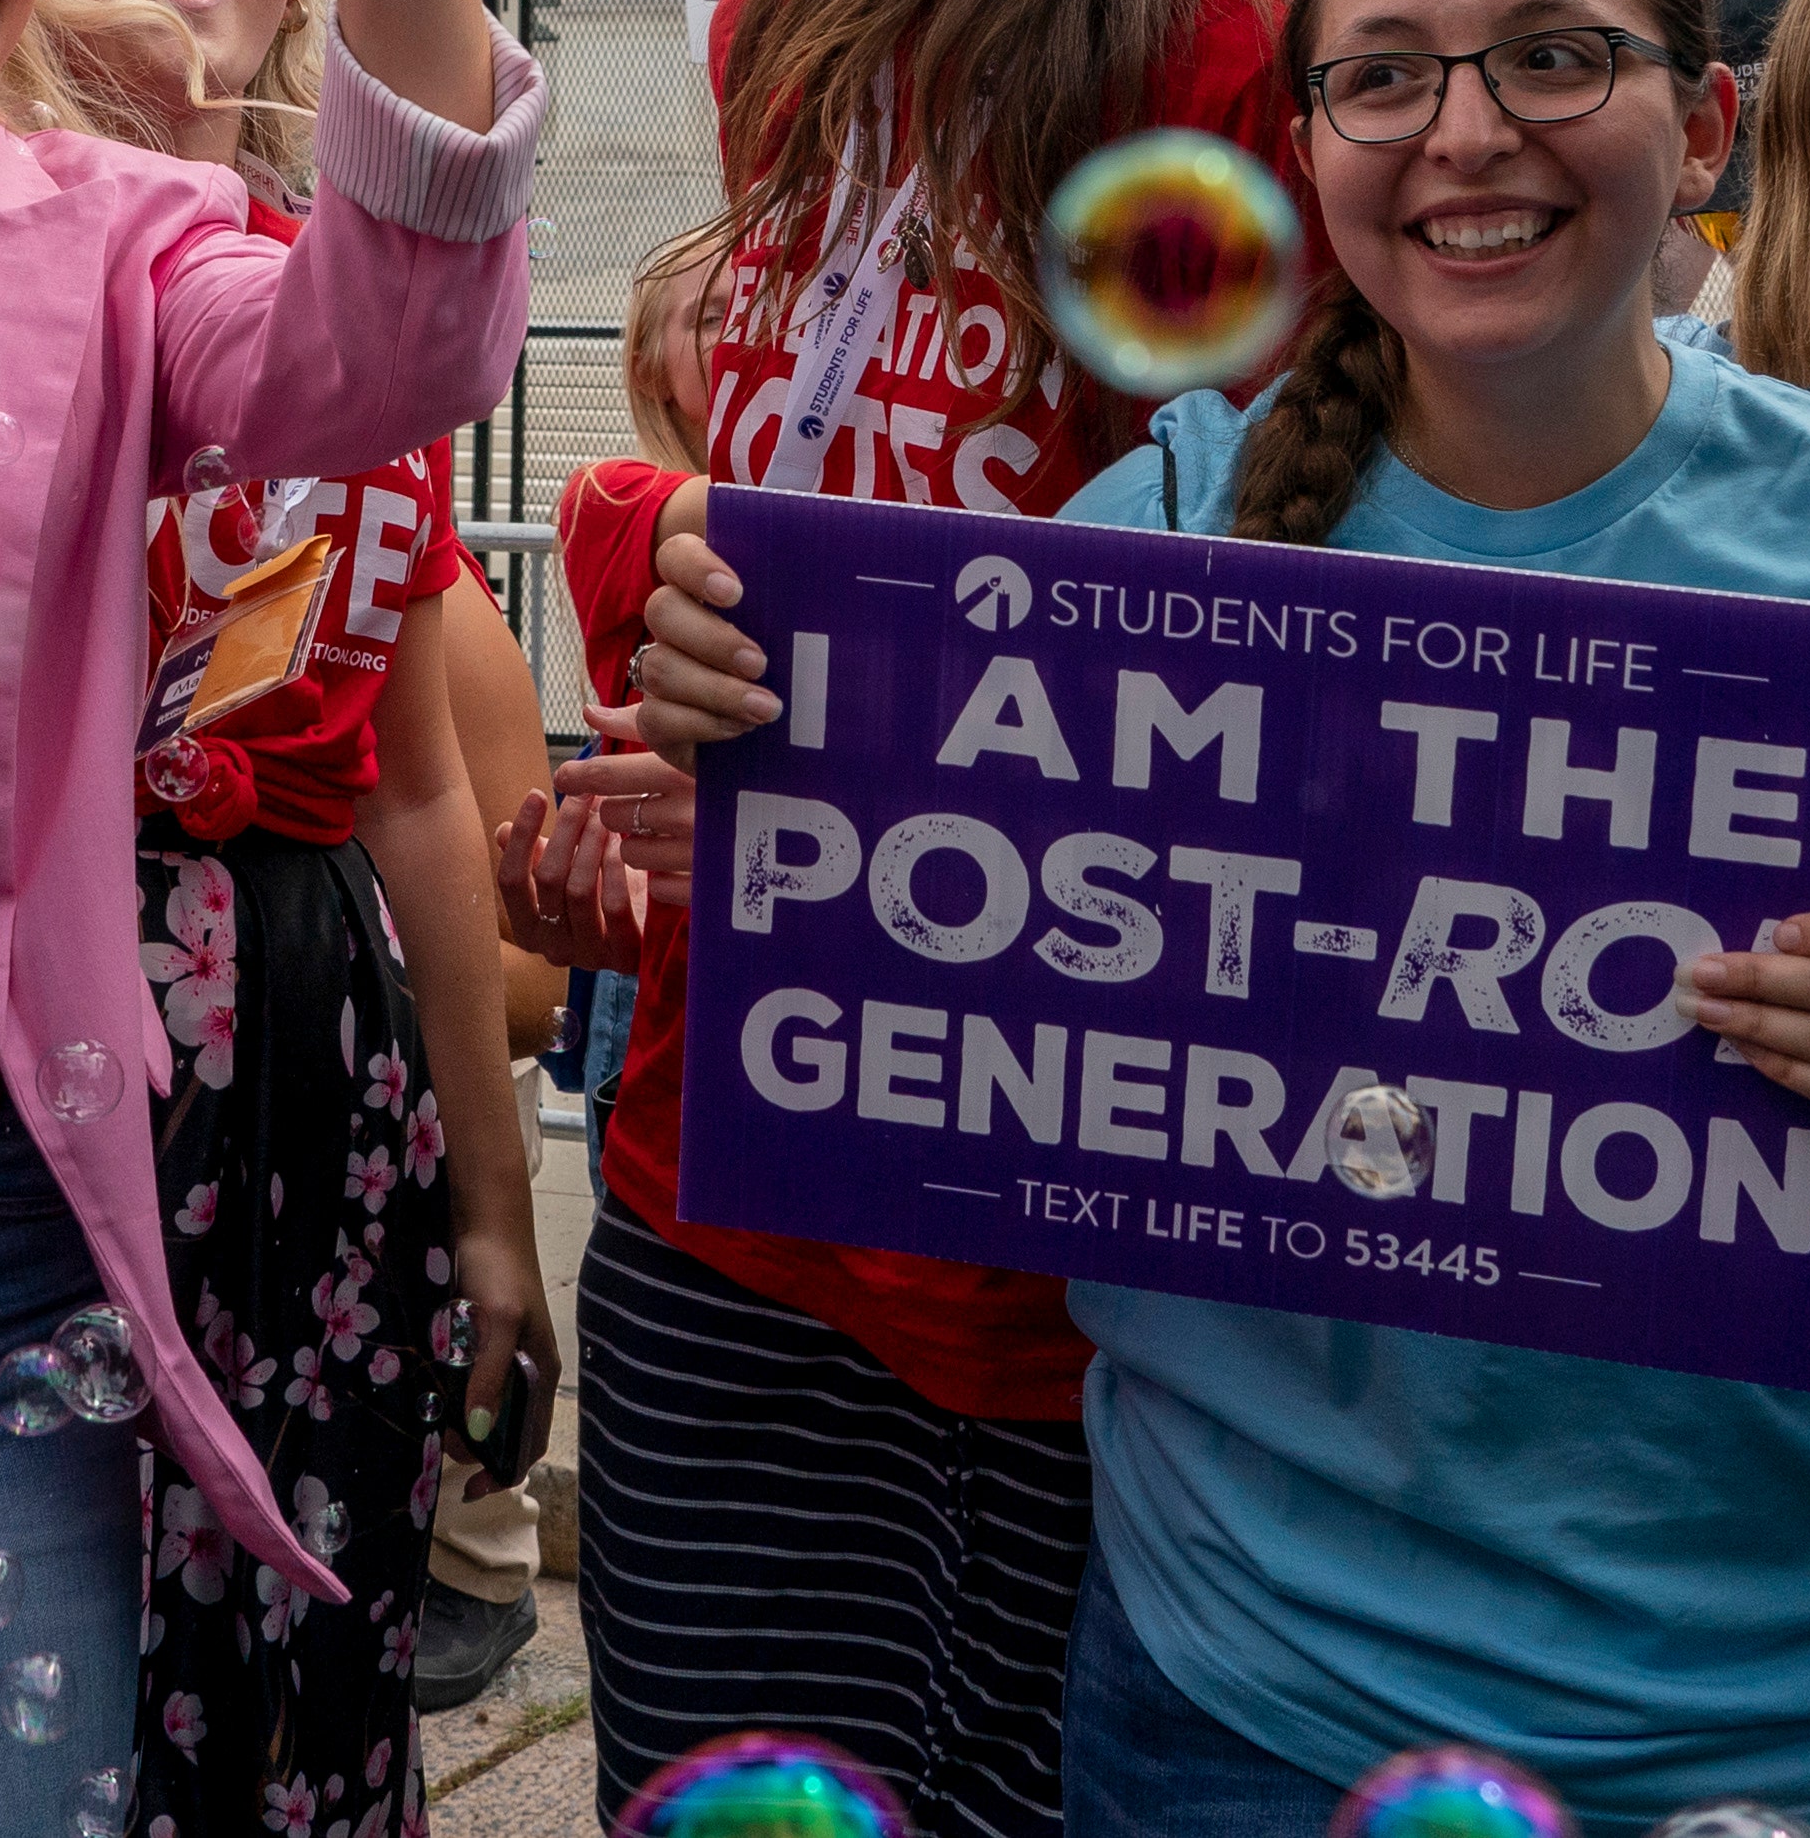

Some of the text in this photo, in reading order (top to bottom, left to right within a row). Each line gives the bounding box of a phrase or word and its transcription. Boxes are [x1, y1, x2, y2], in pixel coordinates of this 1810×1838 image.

[810, 342, 849, 415] STUDENTS
[841, 319, 862, 348] FOR
[854, 286, 874, 323] LIFE
[1049, 579, 1659, 694] STUDENTS FOR LIFE
[790, 632, 1807, 869] I AM THE
[730, 789, 1779, 1066] POST-RO
[1016, 1179, 1502, 1288] TEXT LIFE TO 53445
